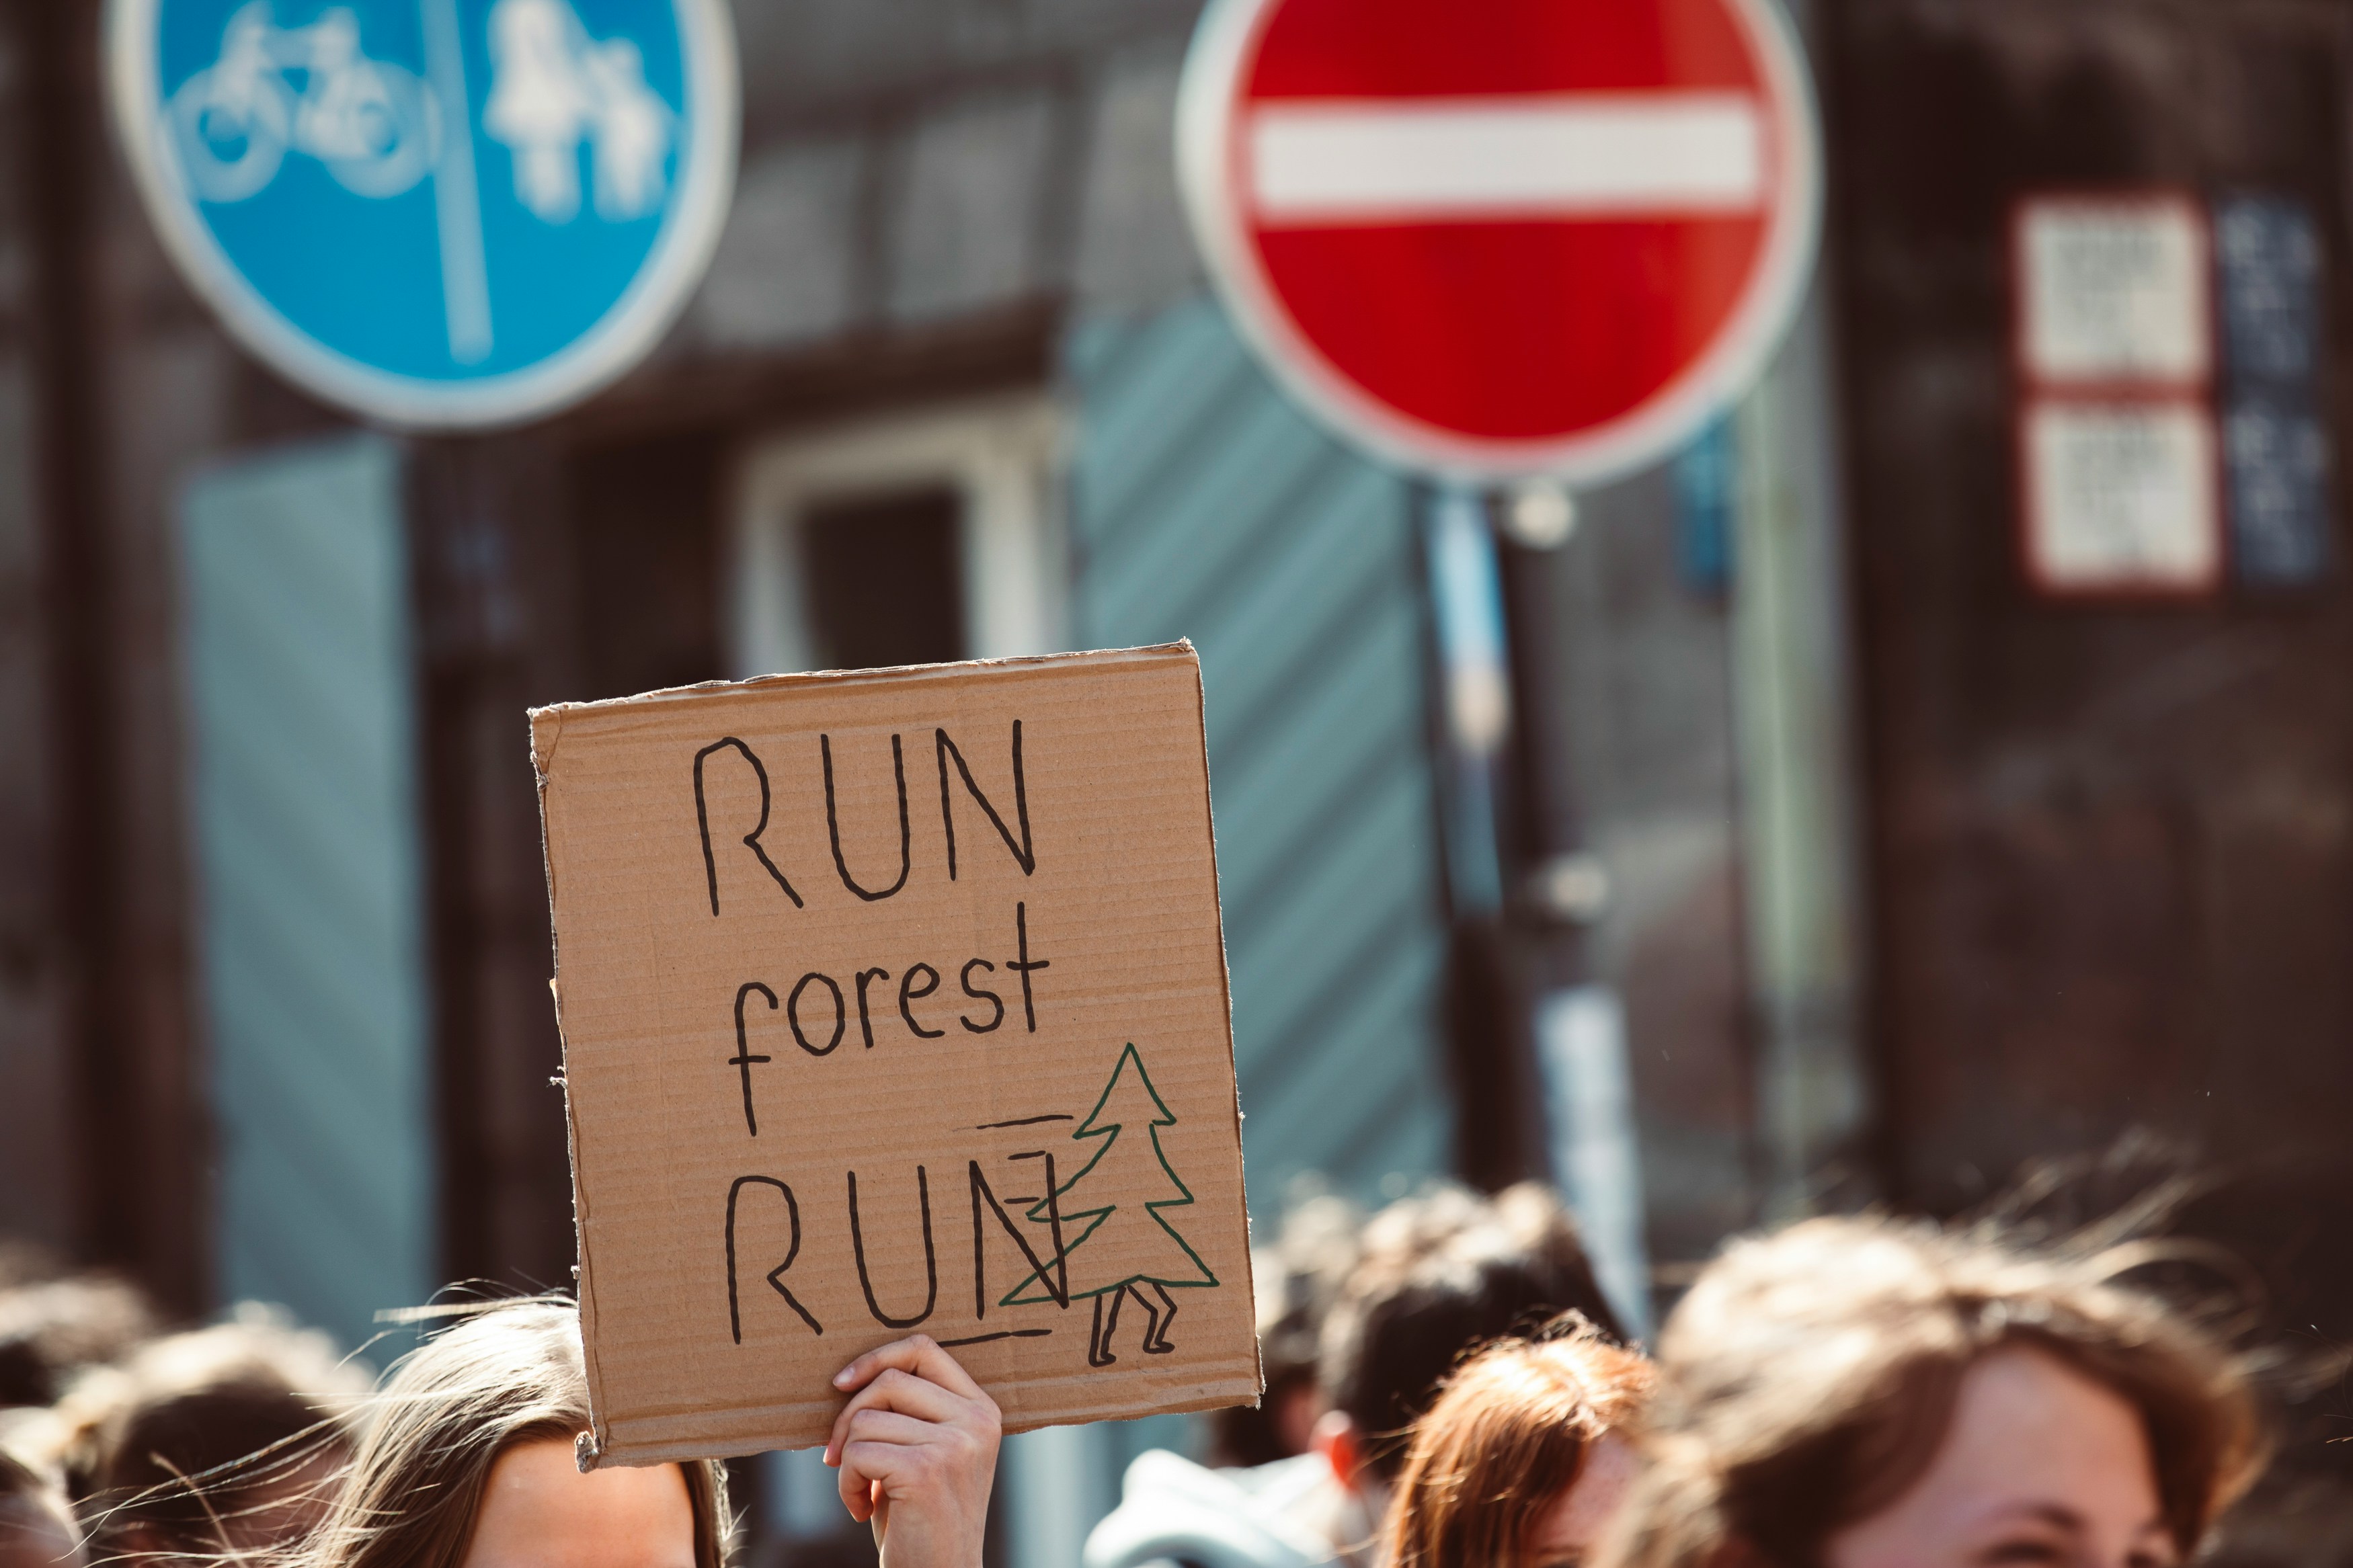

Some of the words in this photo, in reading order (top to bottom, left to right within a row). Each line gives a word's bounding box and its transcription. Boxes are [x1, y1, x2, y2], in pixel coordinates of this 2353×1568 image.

[695, 720, 1035, 915] RUN
[729, 903, 1049, 1136] forest
[727, 1153, 1068, 1343] RUN
